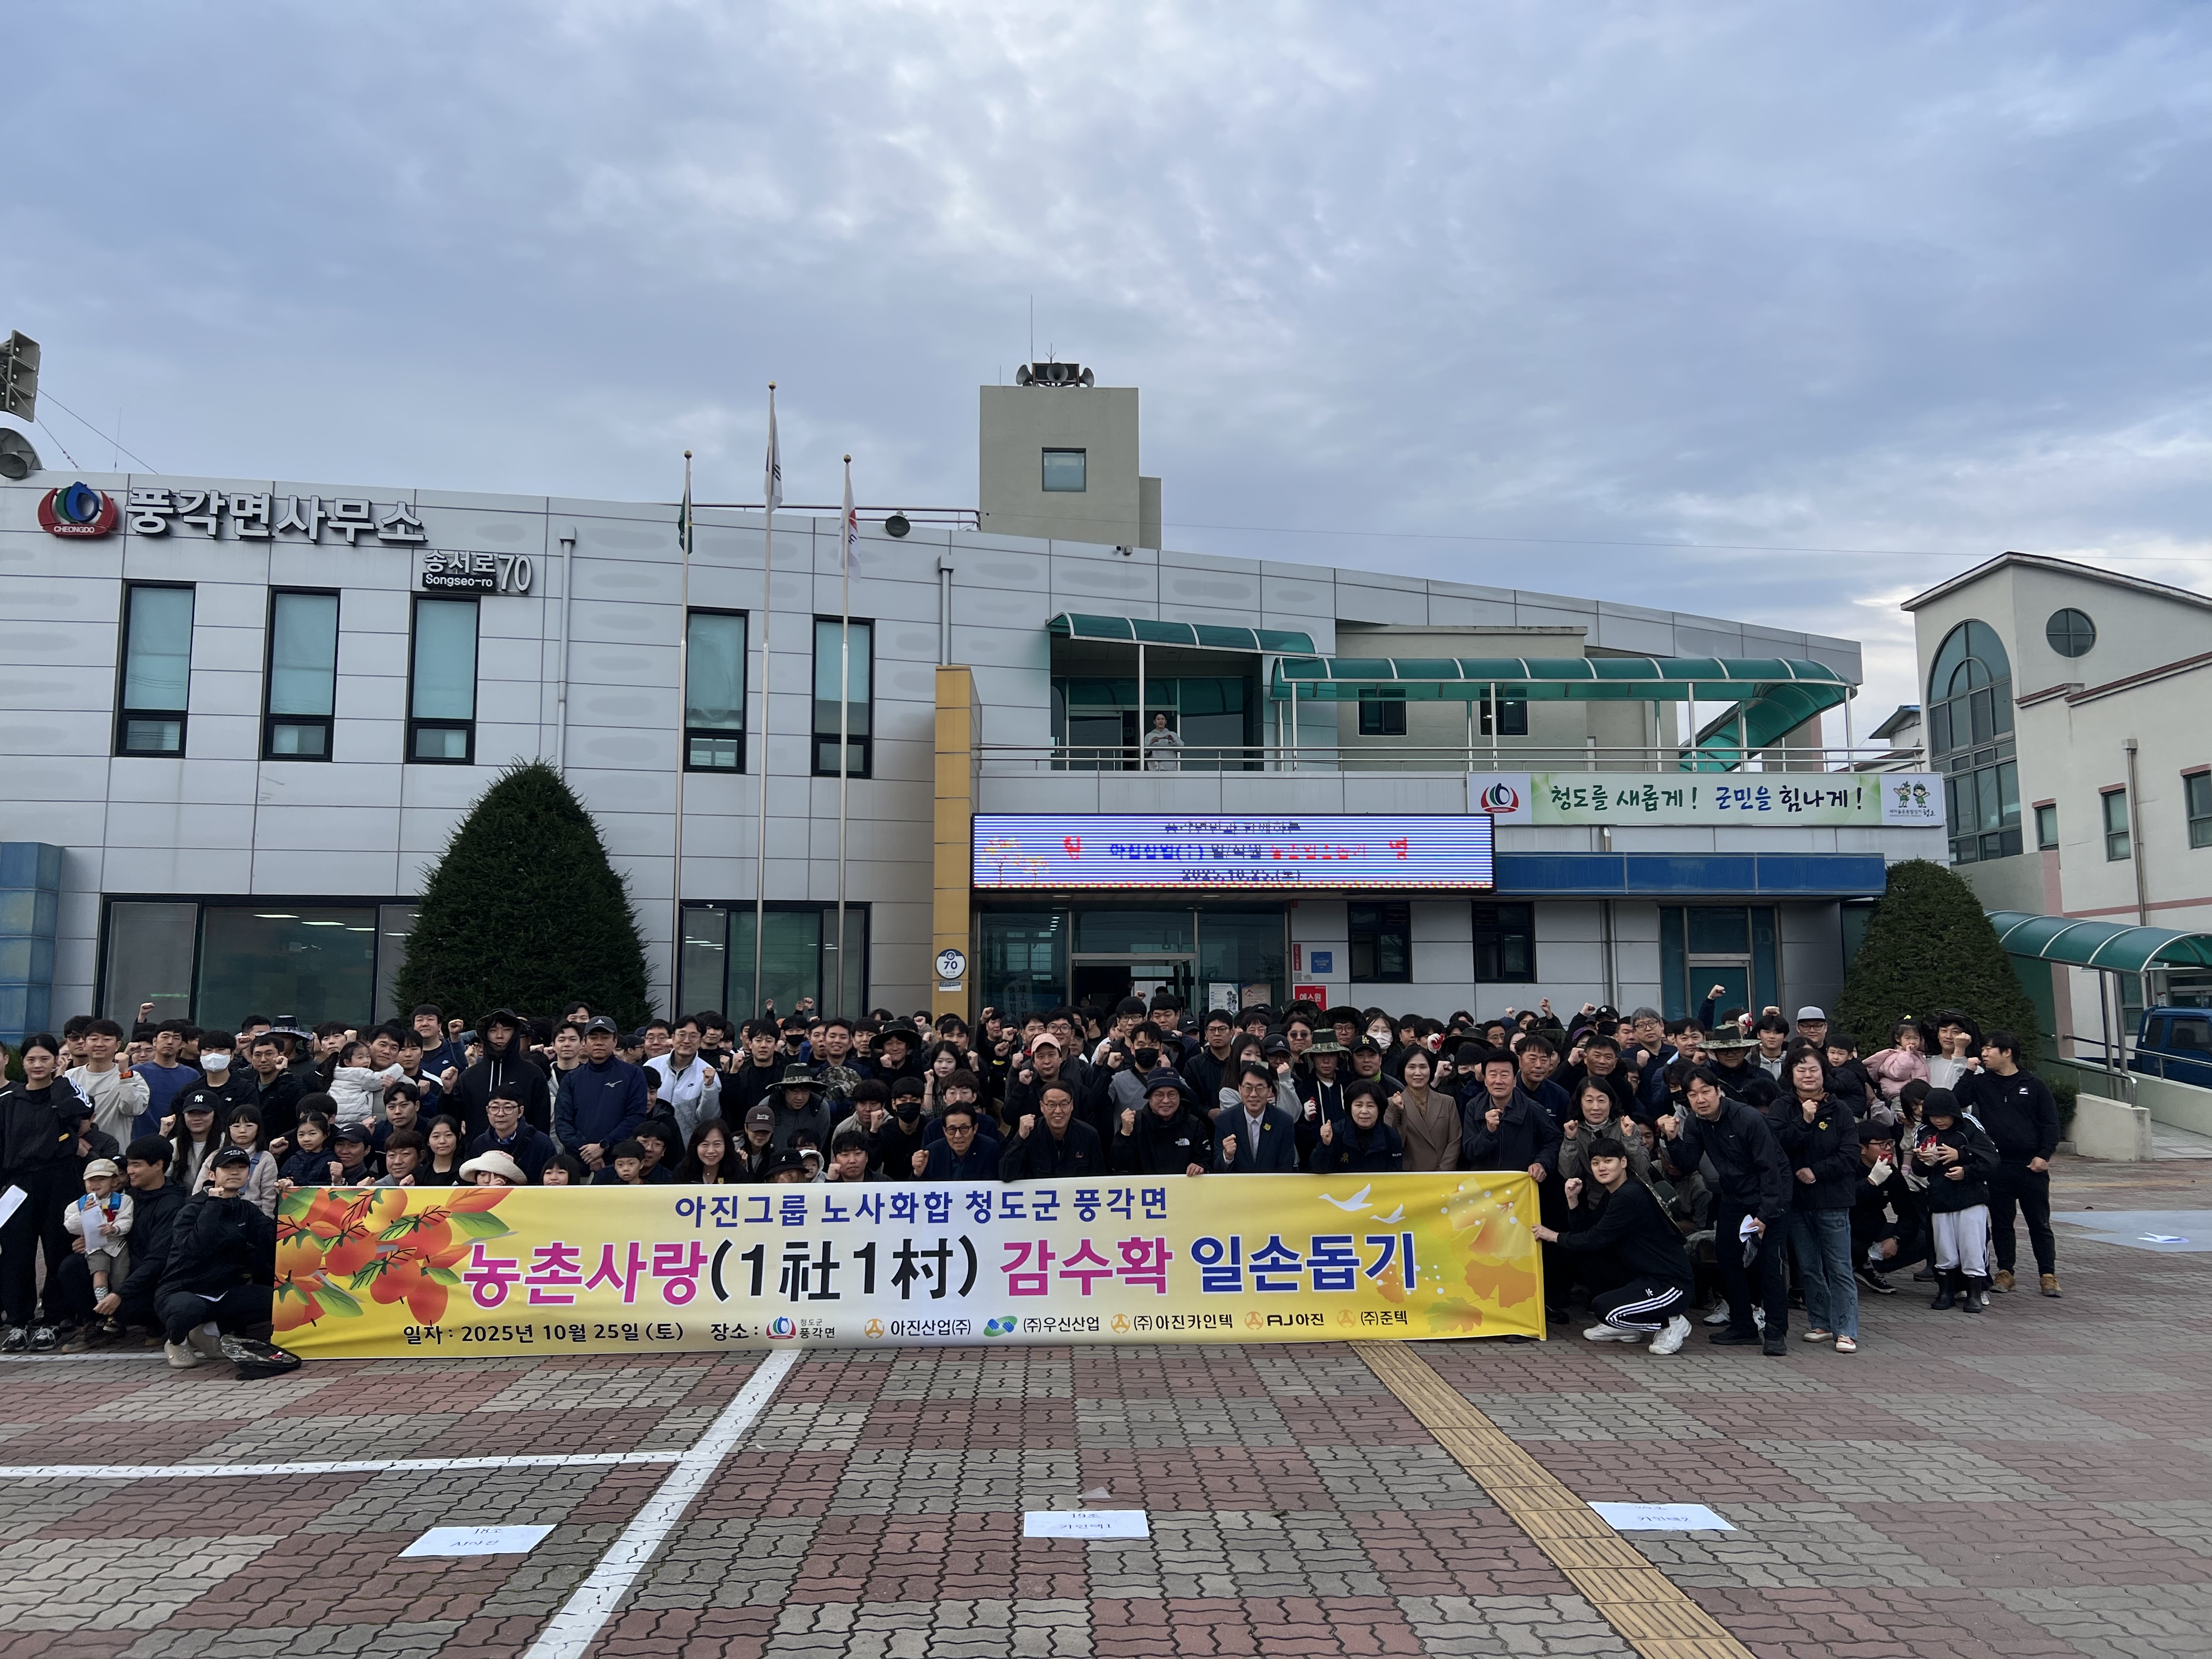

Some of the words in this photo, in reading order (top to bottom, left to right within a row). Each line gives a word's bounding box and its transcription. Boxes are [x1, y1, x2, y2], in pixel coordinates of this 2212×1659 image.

[126, 487, 426, 544] 풍각면사무소
[54, 525, 95, 534] CHEONGDO
[424, 550, 496, 573] 송서로
[499, 554, 532, 591] 70
[425, 574, 493, 588] Songseo-ro
[1550, 785, 1609, 811] 청도를
[1616, 784, 1698, 812] 새롭게!
[1715, 786, 1772, 811] 군민을
[1778, 785, 1863, 812] 힘나게!
[944, 961, 958, 970] 70
[1299, 993, 1322, 1002] 에스원
[1362, 1035, 1370, 1044] LA
[676, 1195, 808, 1228] 아진그룹
[822, 1190, 953, 1224] 노사화합
[965, 1189, 1060, 1224] 청도군
[1073, 1187, 1168, 1221] 풍각면
[1000, 1235, 1173, 1297] 감수확
[1190, 1232, 1417, 1294] 일손돕기
[800, 1318, 823, 1327] 청도군
[1023, 1316, 1100, 1334] (주)우신산업
[1133, 1312, 1233, 1332] (주)아진카인텍
[1267, 1312, 1325, 1328] AJ아진
[1360, 1310, 1408, 1326] (주)준텍
[460, 1324, 534, 1344] 2025년
[543, 1323, 586, 1343] 10월
[799, 1327, 835, 1339] 풍각면
[890, 1318, 972, 1338] 아진산업(주)
